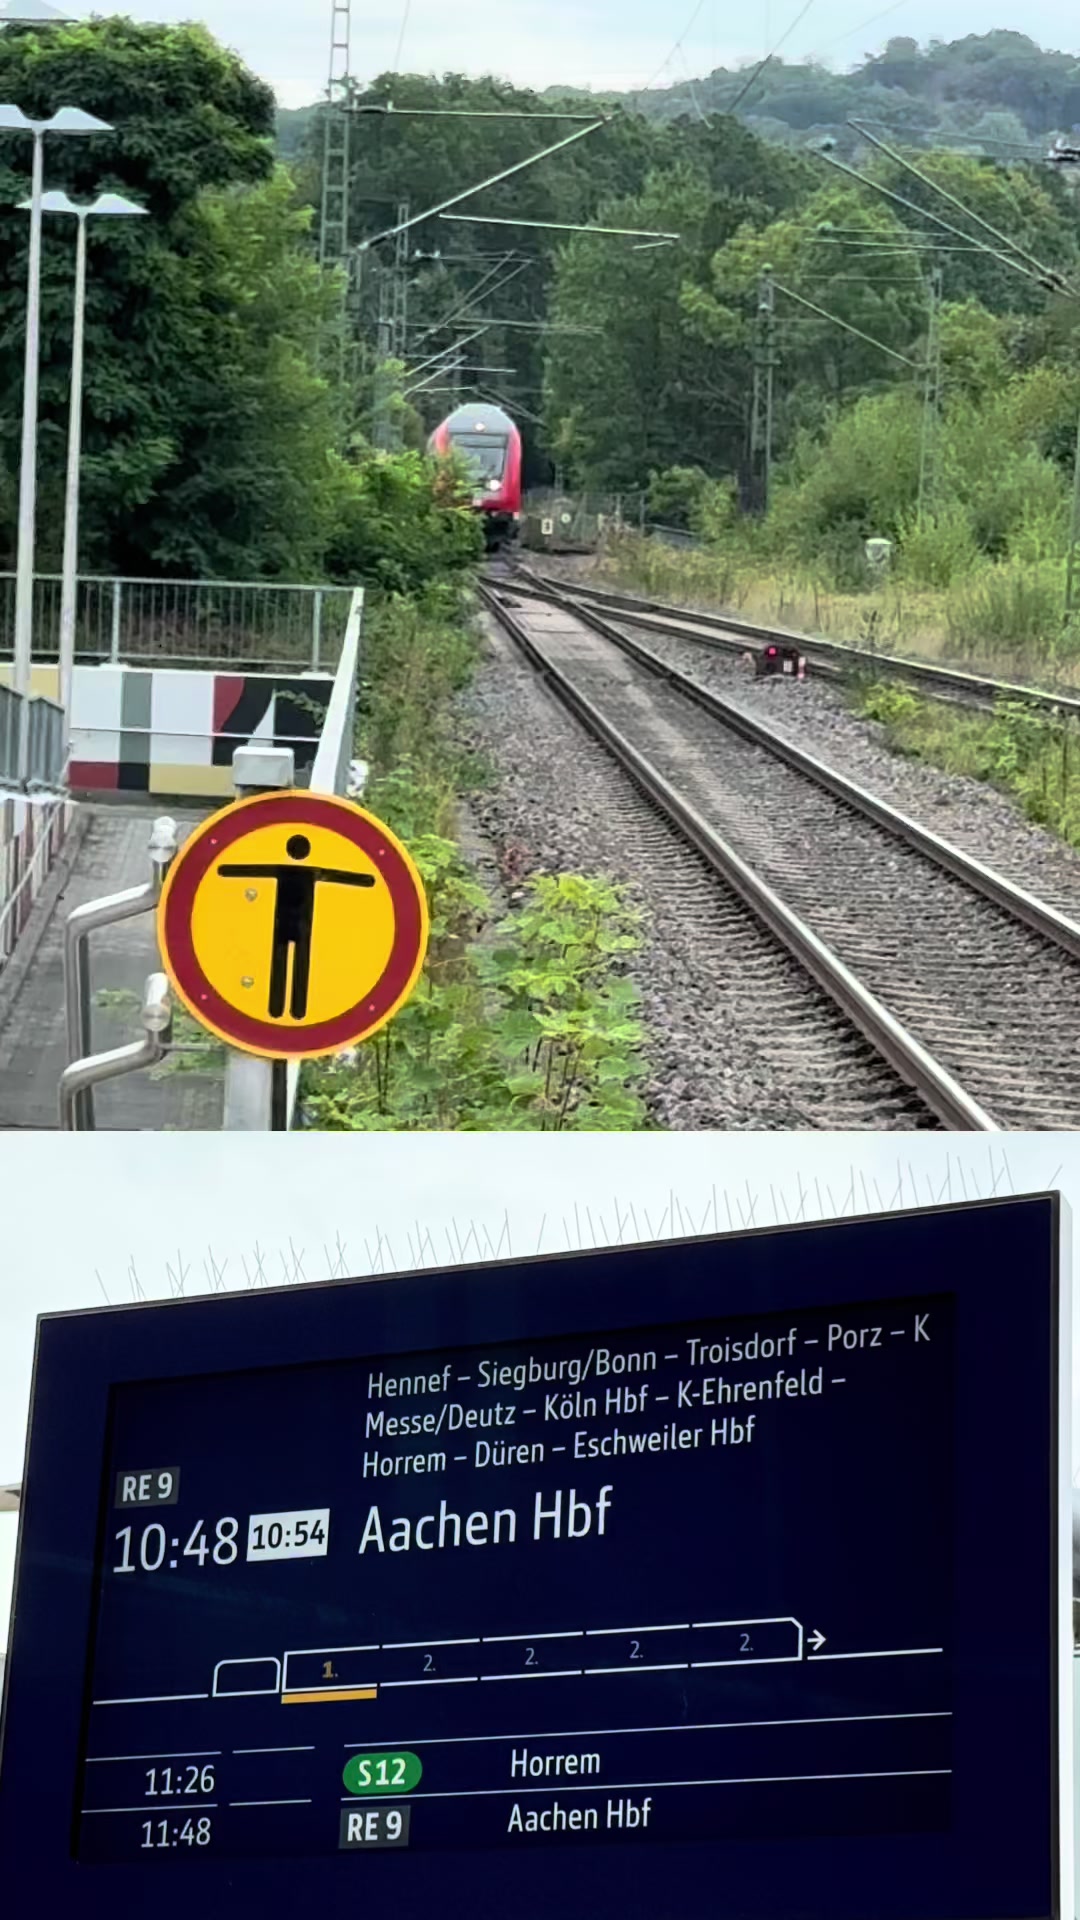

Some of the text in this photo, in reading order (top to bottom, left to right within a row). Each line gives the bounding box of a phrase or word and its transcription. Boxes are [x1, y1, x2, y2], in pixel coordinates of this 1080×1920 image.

[367, 1364, 452, 1399] Hennef
[477, 1348, 657, 1391] Siegburg/Bonn
[686, 1327, 797, 1366] Troisdorf
[828, 1323, 882, 1351] Porz
[914, 1313, 930, 1342] K
[365, 1402, 516, 1439] Messe/Deutz
[544, 1391, 597, 1421] Köln
[605, 1384, 649, 1416] Hbf
[677, 1366, 823, 1408] K-Ehrenfeld
[362, 1451, 446, 1478] Horrem
[474, 1439, 544, 1468] Düren
[573, 1422, 703, 1460] Eschweiler
[711, 1414, 756, 1446] Hbf
[122, 1472, 173, 1502] RE 9
[252, 1519, 326, 1550] 10:54
[358, 1484, 614, 1555] Aachen Hbf
[113, 1516, 239, 1573] 10:48
[524, 1647, 539, 1666] 2.
[629, 1640, 644, 1659] 2.
[739, 1633, 754, 1652] 2.
[322, 1660, 339, 1679] 1.
[423, 1653, 437, 1672] 2.
[357, 1756, 407, 1788] S12
[511, 1748, 601, 1778] Horrem
[145, 1764, 215, 1796] 11:26
[347, 1810, 403, 1842] RE 9
[507, 1797, 652, 1833] Aachen Hbf
[141, 1817, 211, 1848] 11:48
